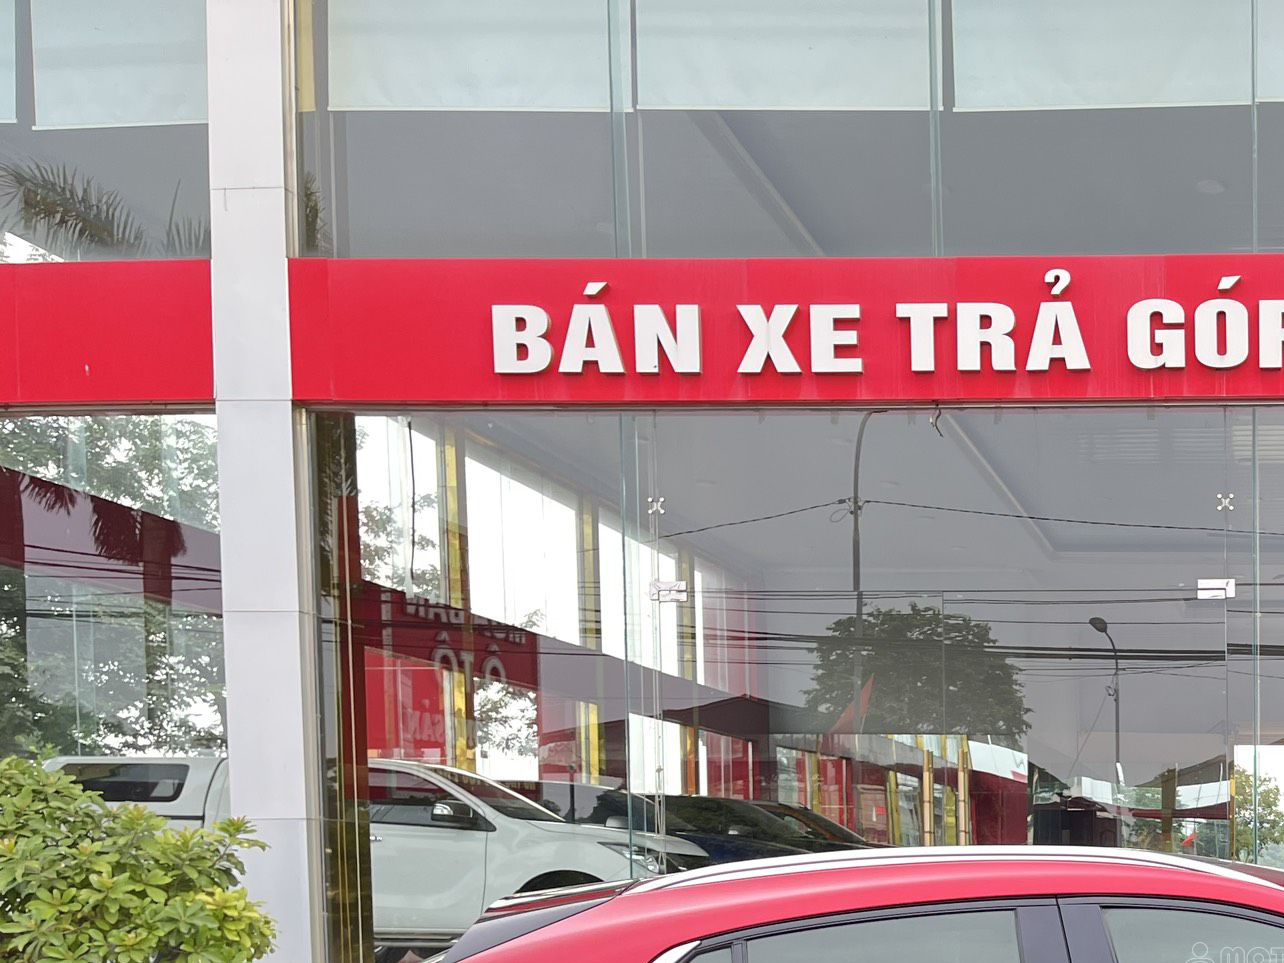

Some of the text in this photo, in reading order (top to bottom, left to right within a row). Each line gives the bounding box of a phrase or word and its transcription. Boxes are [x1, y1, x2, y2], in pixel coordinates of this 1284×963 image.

[492, 282, 702, 374] BÁN
[736, 304, 864, 374] XE
[896, 268, 1091, 371] TRẢ
